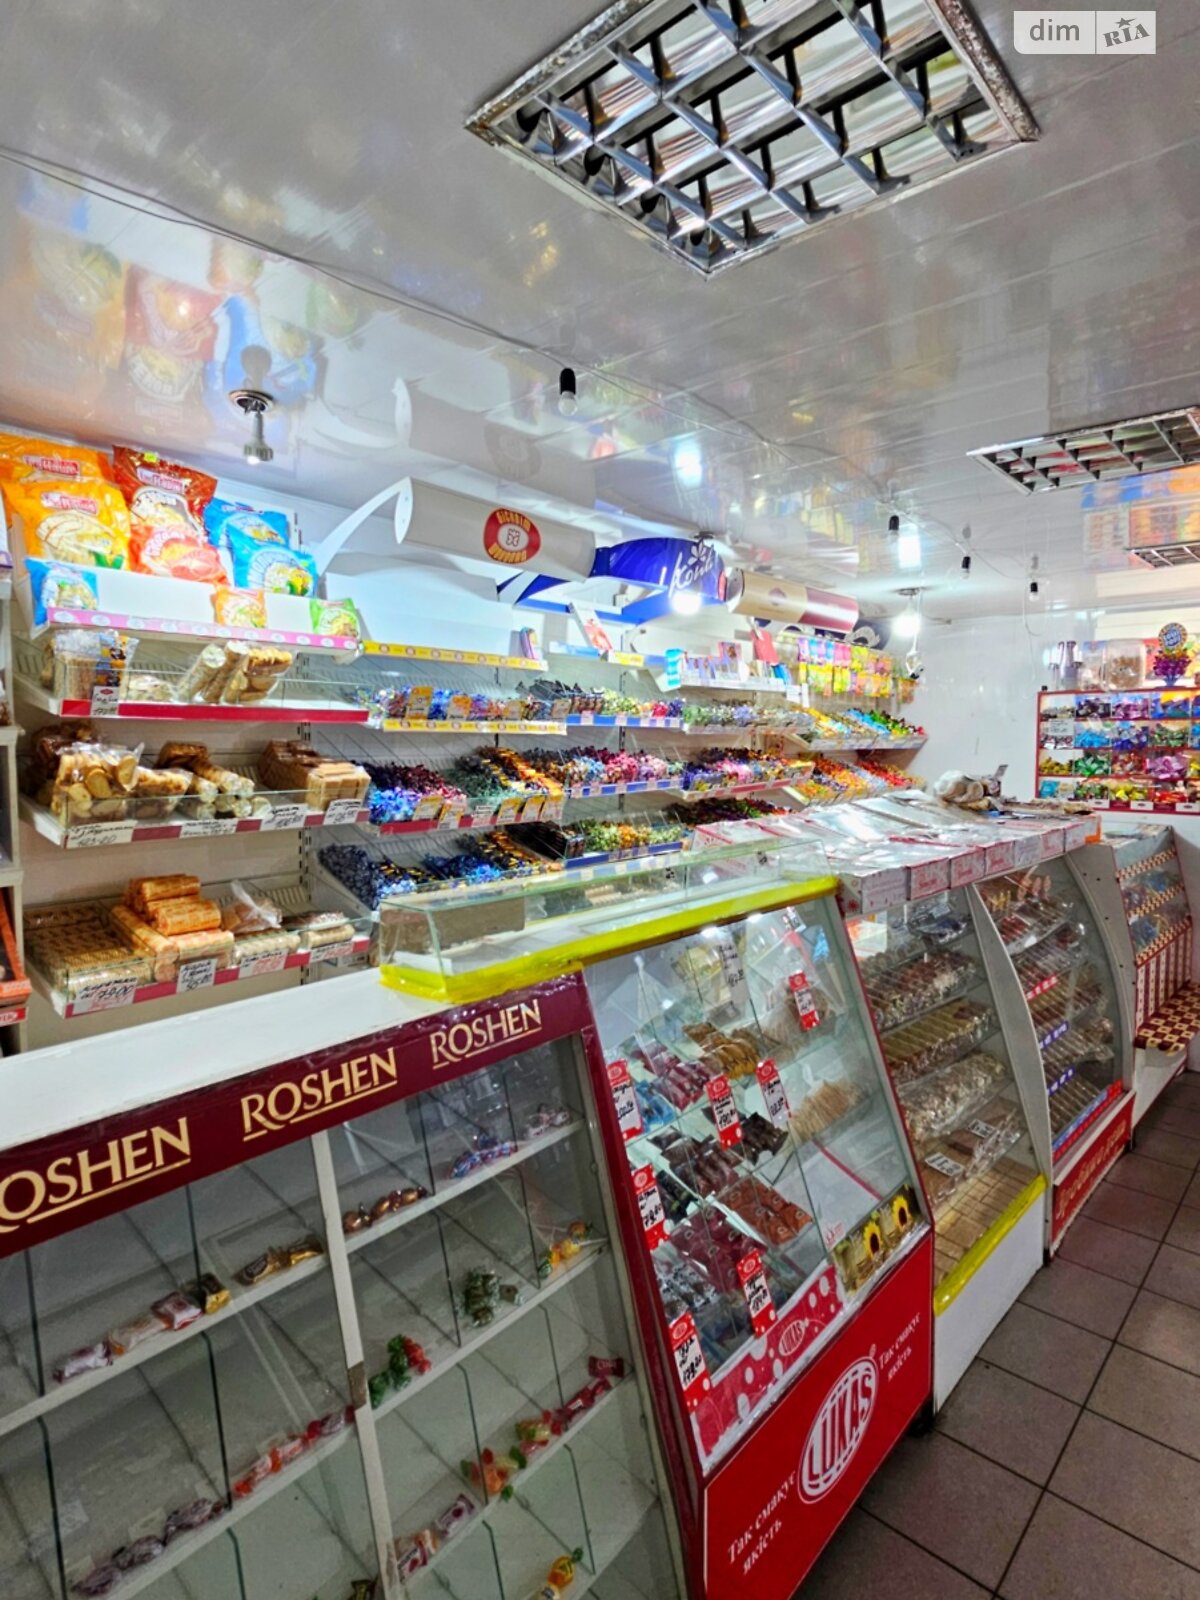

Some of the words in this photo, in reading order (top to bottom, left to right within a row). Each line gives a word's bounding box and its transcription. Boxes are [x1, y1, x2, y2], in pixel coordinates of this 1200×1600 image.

[430, 998, 542, 1068] ROSHEN
[241, 1047, 398, 1140] ROSHEN
[0, 1117, 191, 1230] OSHEN
[879, 1345, 896, 1370] Так
[807, 1372, 874, 1482] LUKAS
[728, 1524, 753, 1565] Так
[754, 1470, 797, 1532] смакує
[743, 1518, 783, 1576] якість
